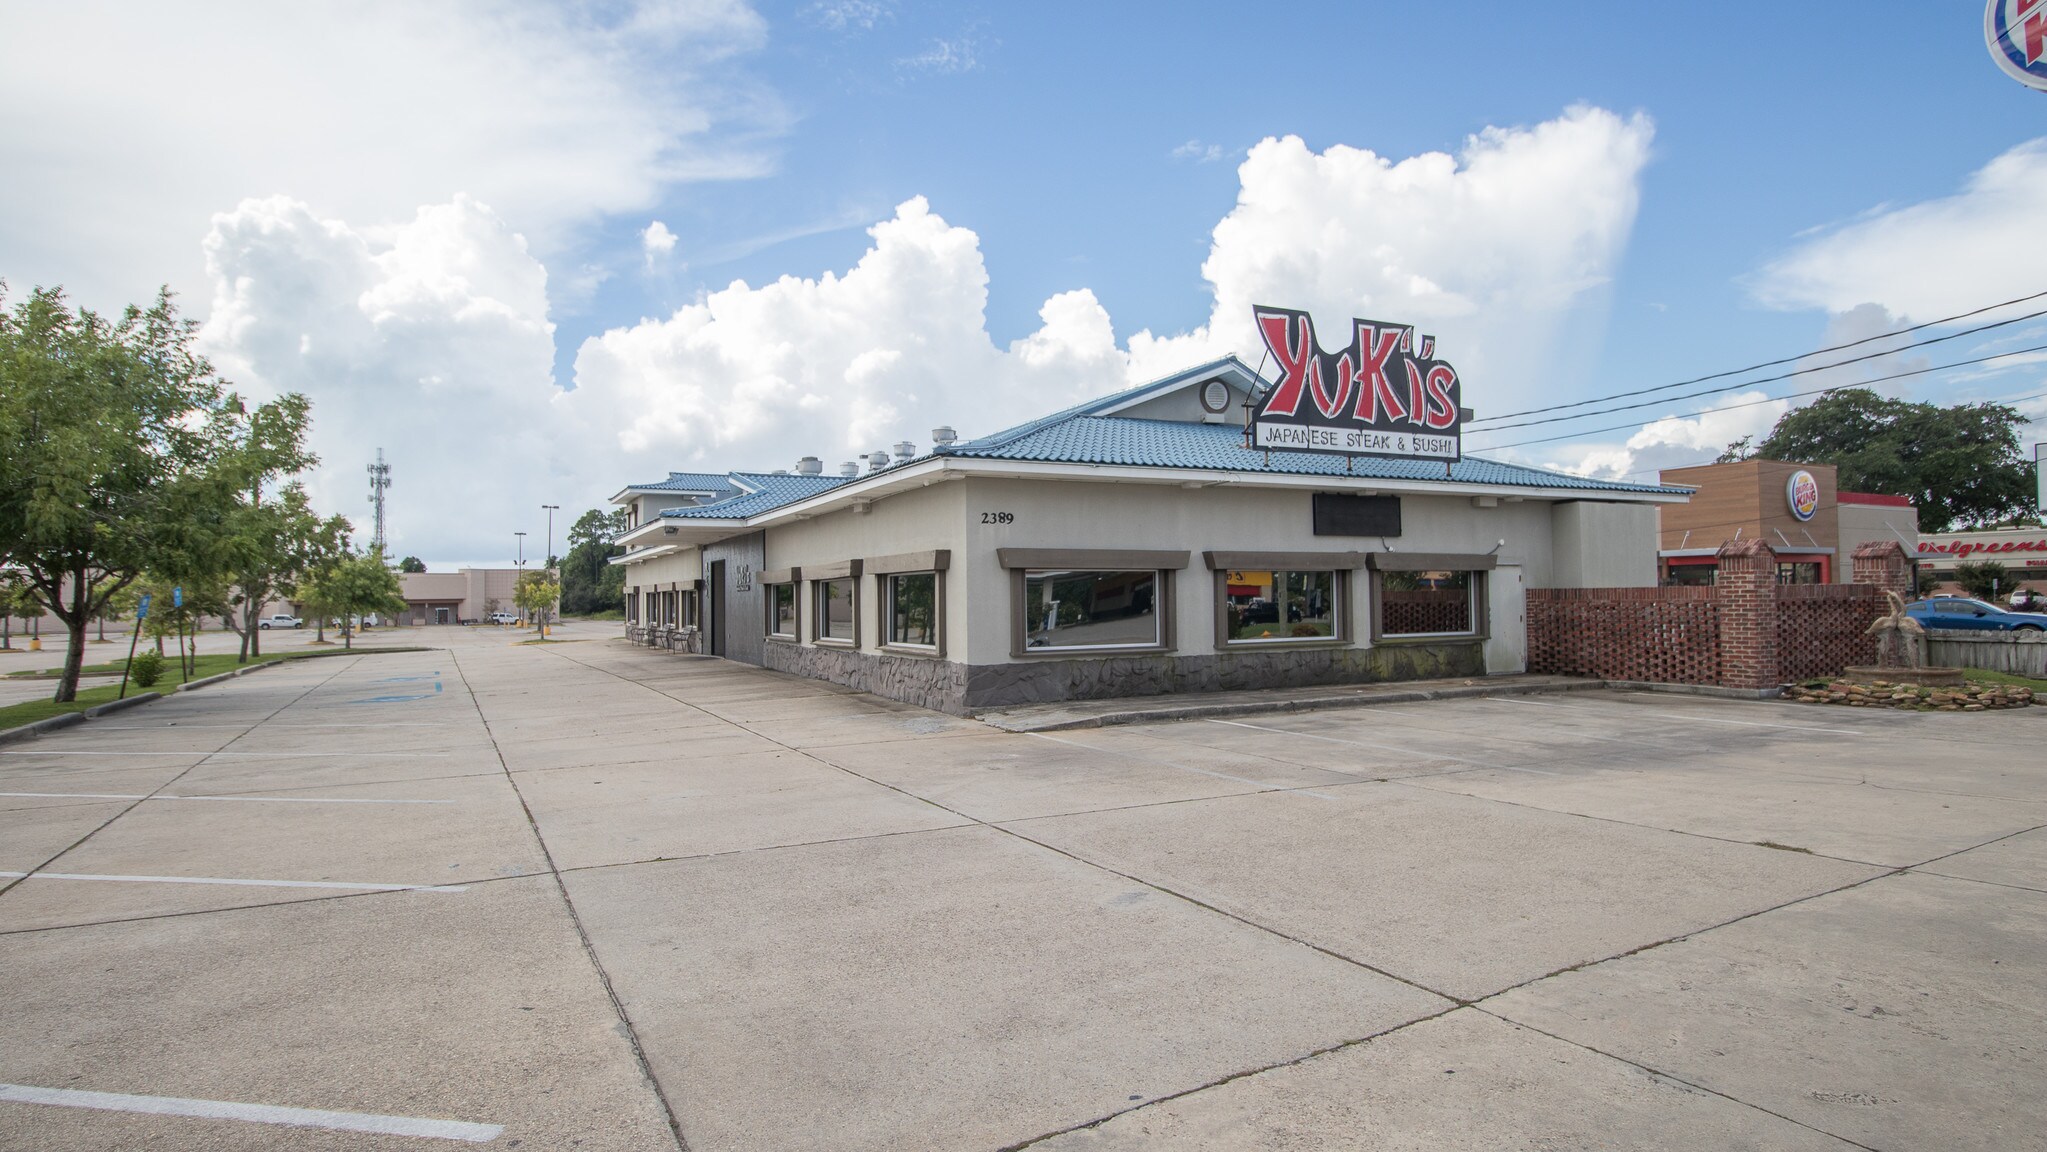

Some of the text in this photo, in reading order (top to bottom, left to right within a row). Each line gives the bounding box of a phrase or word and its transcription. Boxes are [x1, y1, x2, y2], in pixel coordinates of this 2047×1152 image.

[1265, 427, 1453, 453] JAPANESE STEAK & SUSHI
[1795, 490, 1816, 508] KING
[981, 512, 1014, 524] 2389
